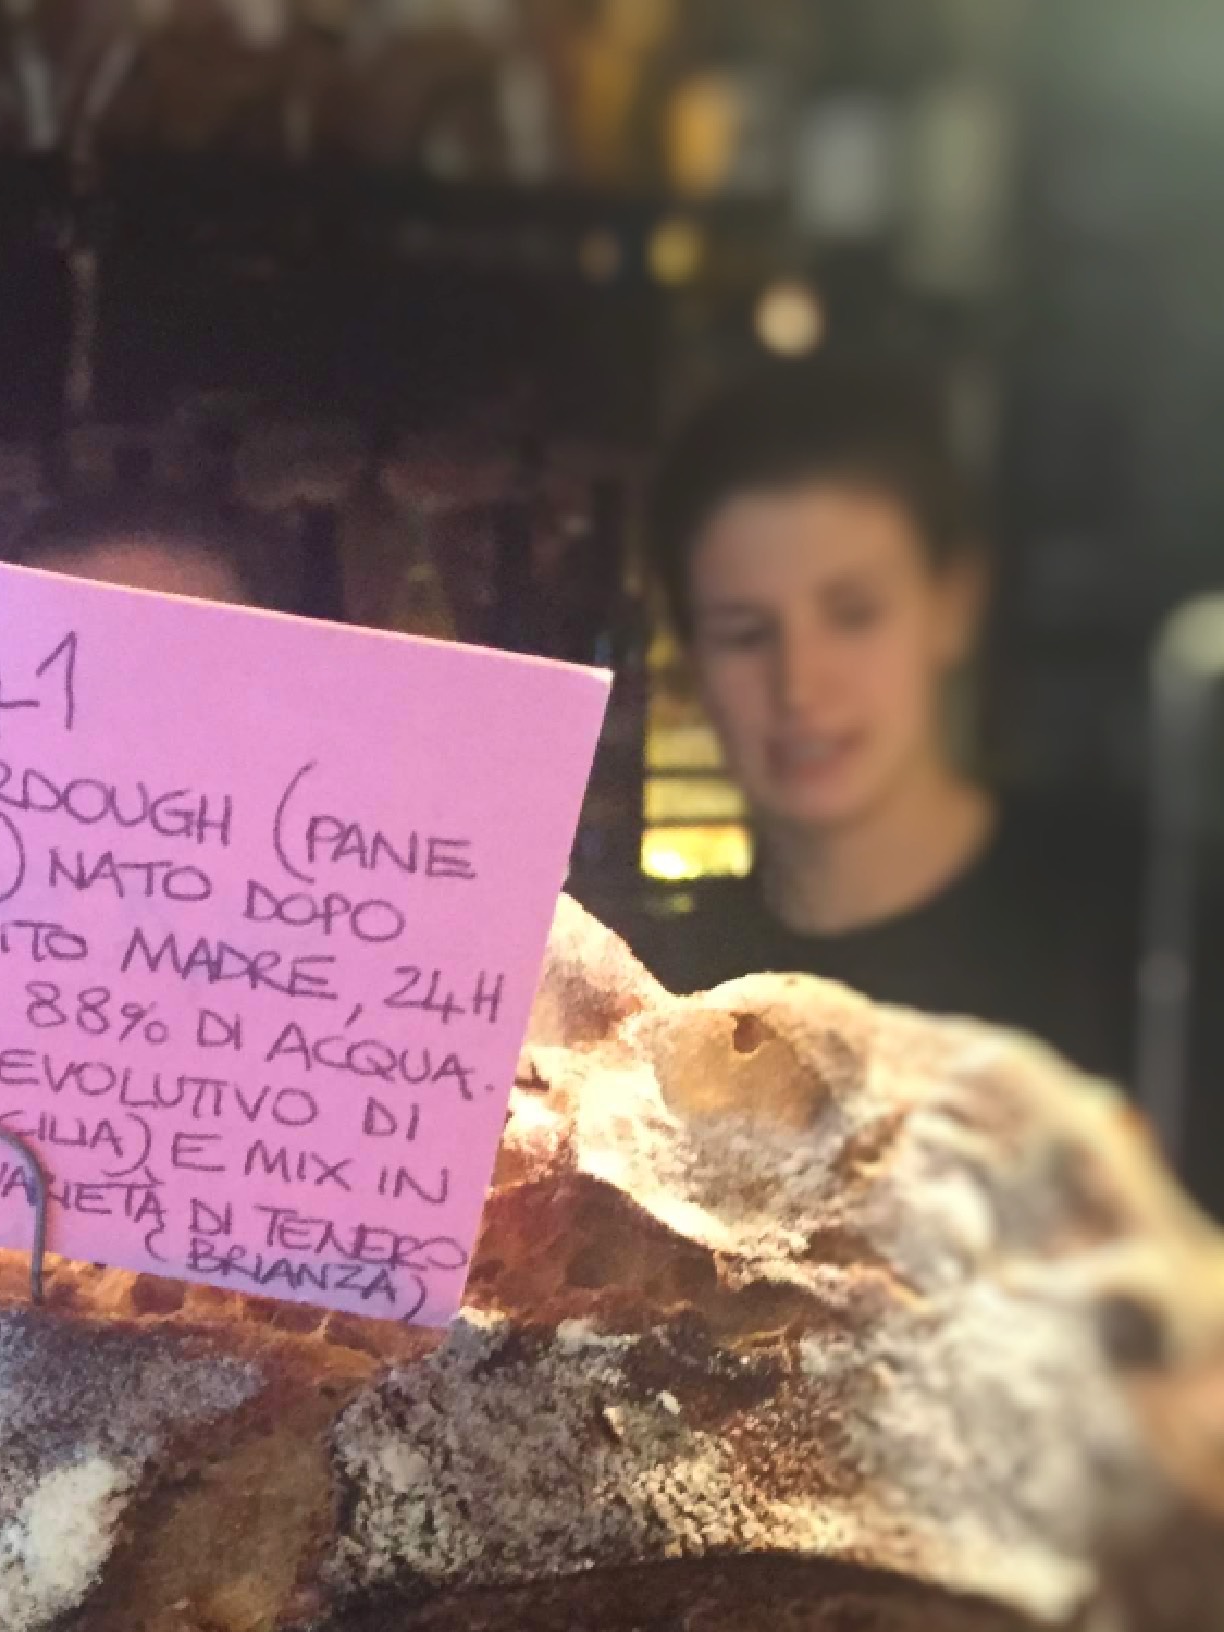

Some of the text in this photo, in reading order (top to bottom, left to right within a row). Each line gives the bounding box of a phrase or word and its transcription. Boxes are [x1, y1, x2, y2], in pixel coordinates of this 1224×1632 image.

[273, 760, 477, 884] (PANE
[48, 846, 213, 902] NATO
[243, 878, 407, 943] DOPO
[120, 927, 362, 1028] MADRE,
[384, 965, 505, 1024] 24H
[25, 980, 169, 1045] 88%
[196, 1009, 243, 1051] DI
[265, 1022, 498, 1100] ACQUA.
[361, 1097, 419, 1141] DI
[171, 1132, 226, 1173] E
[243, 1139, 355, 1192] MIX
[377, 1165, 449, 1206] IN
[188, 1197, 233, 1237] DI
[253, 1204, 469, 1273] TENERO
